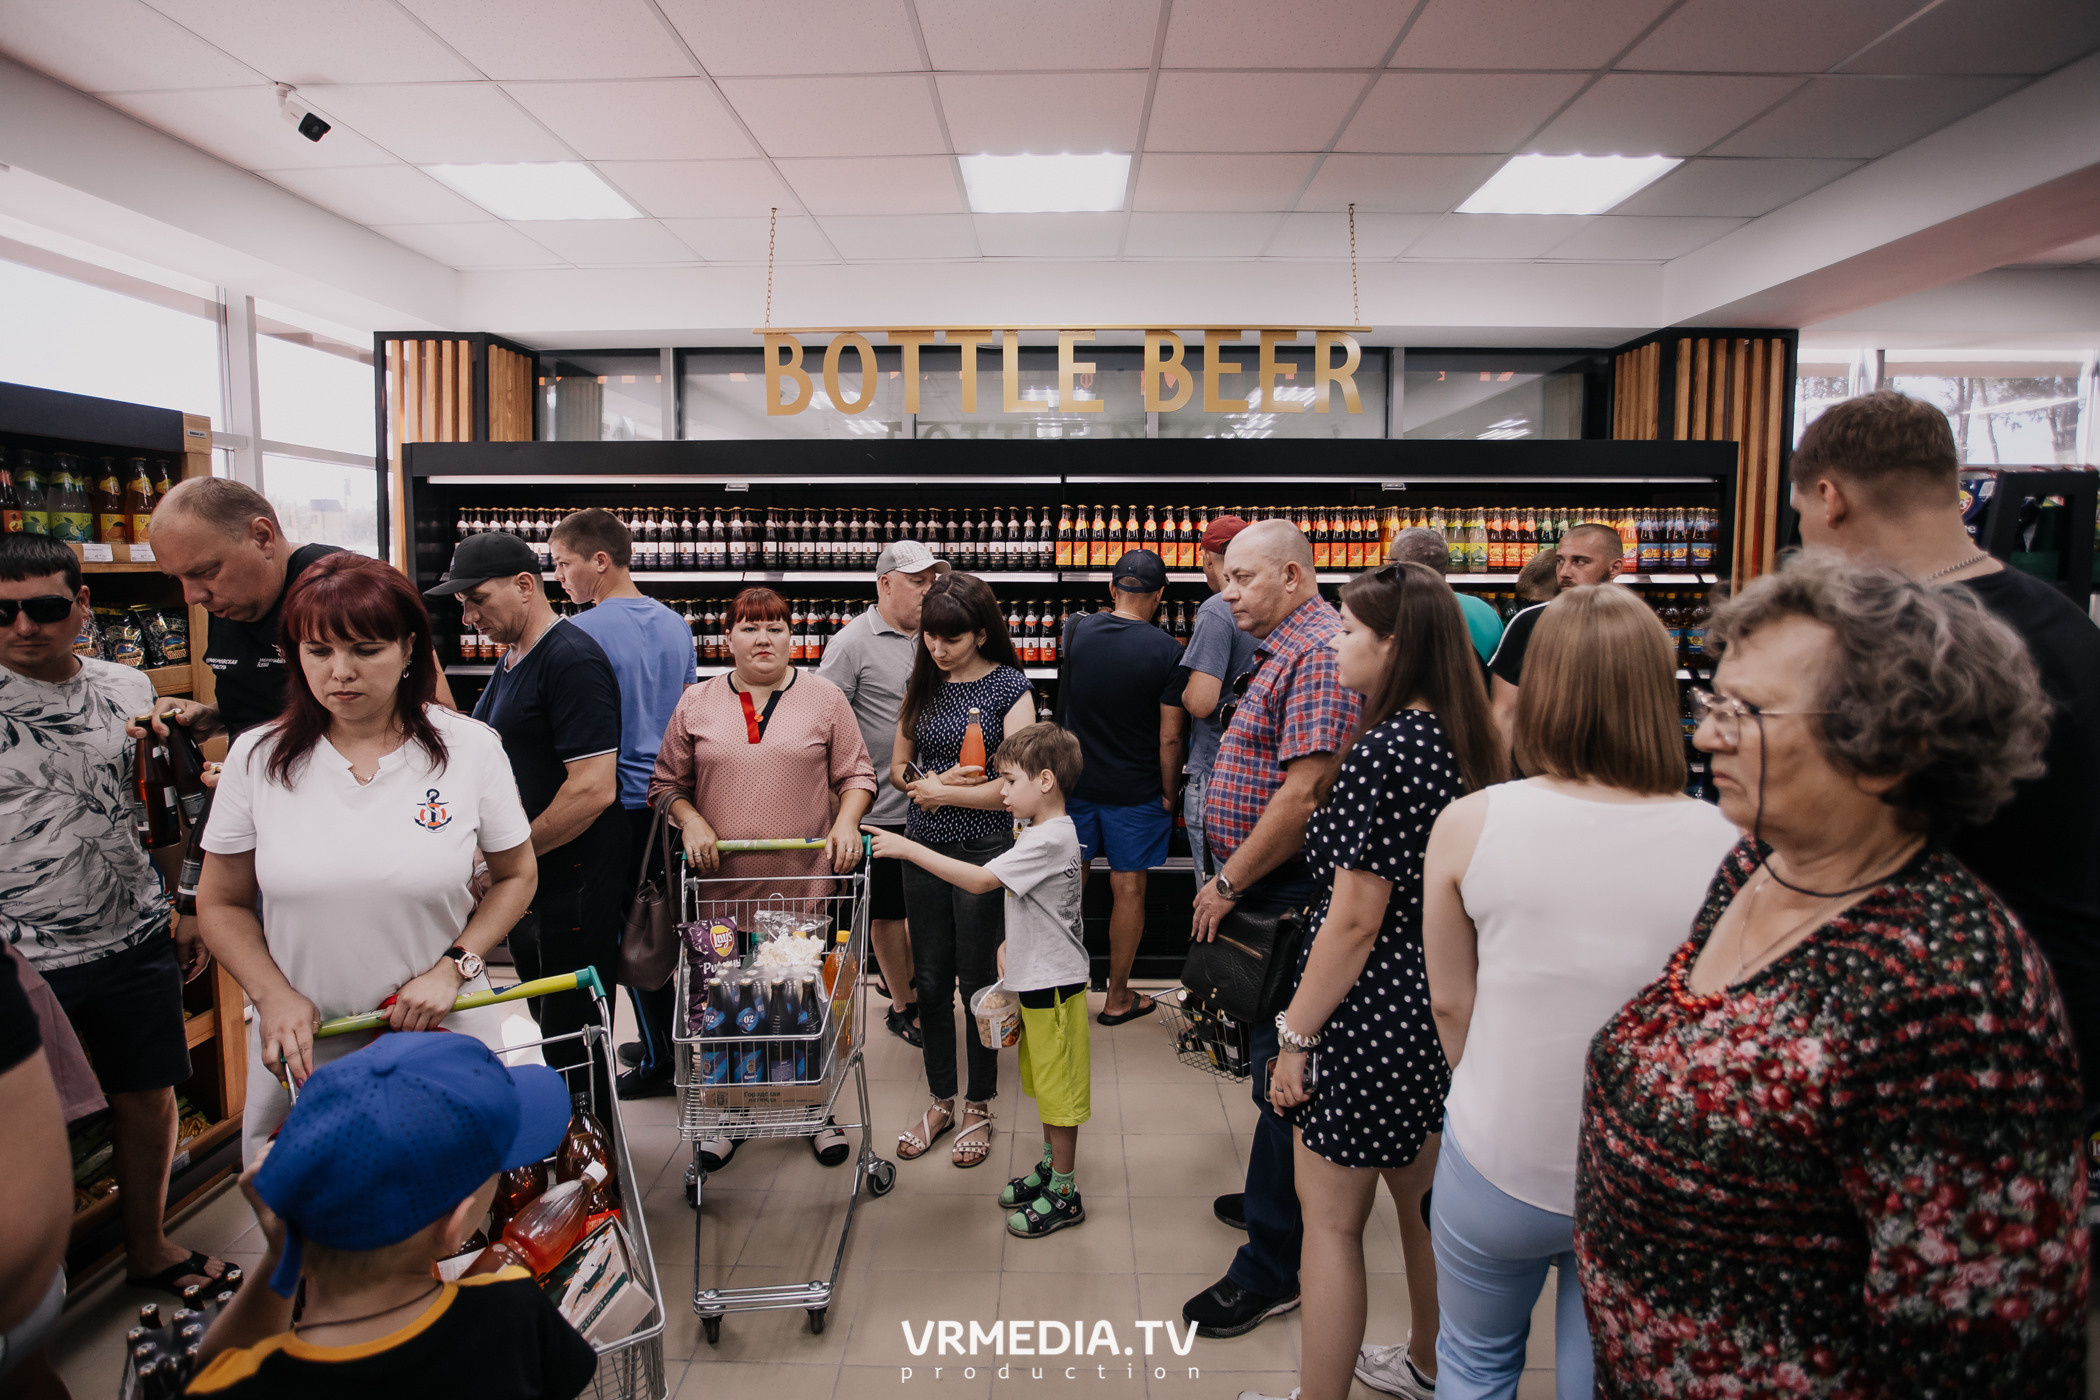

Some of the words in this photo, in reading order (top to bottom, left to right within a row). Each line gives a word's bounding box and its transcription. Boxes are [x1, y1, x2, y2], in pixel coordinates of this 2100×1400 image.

[764, 330, 1105, 416] BOTTLE
[1144, 329, 1364, 414] BEER
[712, 930, 733, 949] Lay's
[705, 1014, 715, 1023] 02
[743, 1014, 754, 1024] 02
